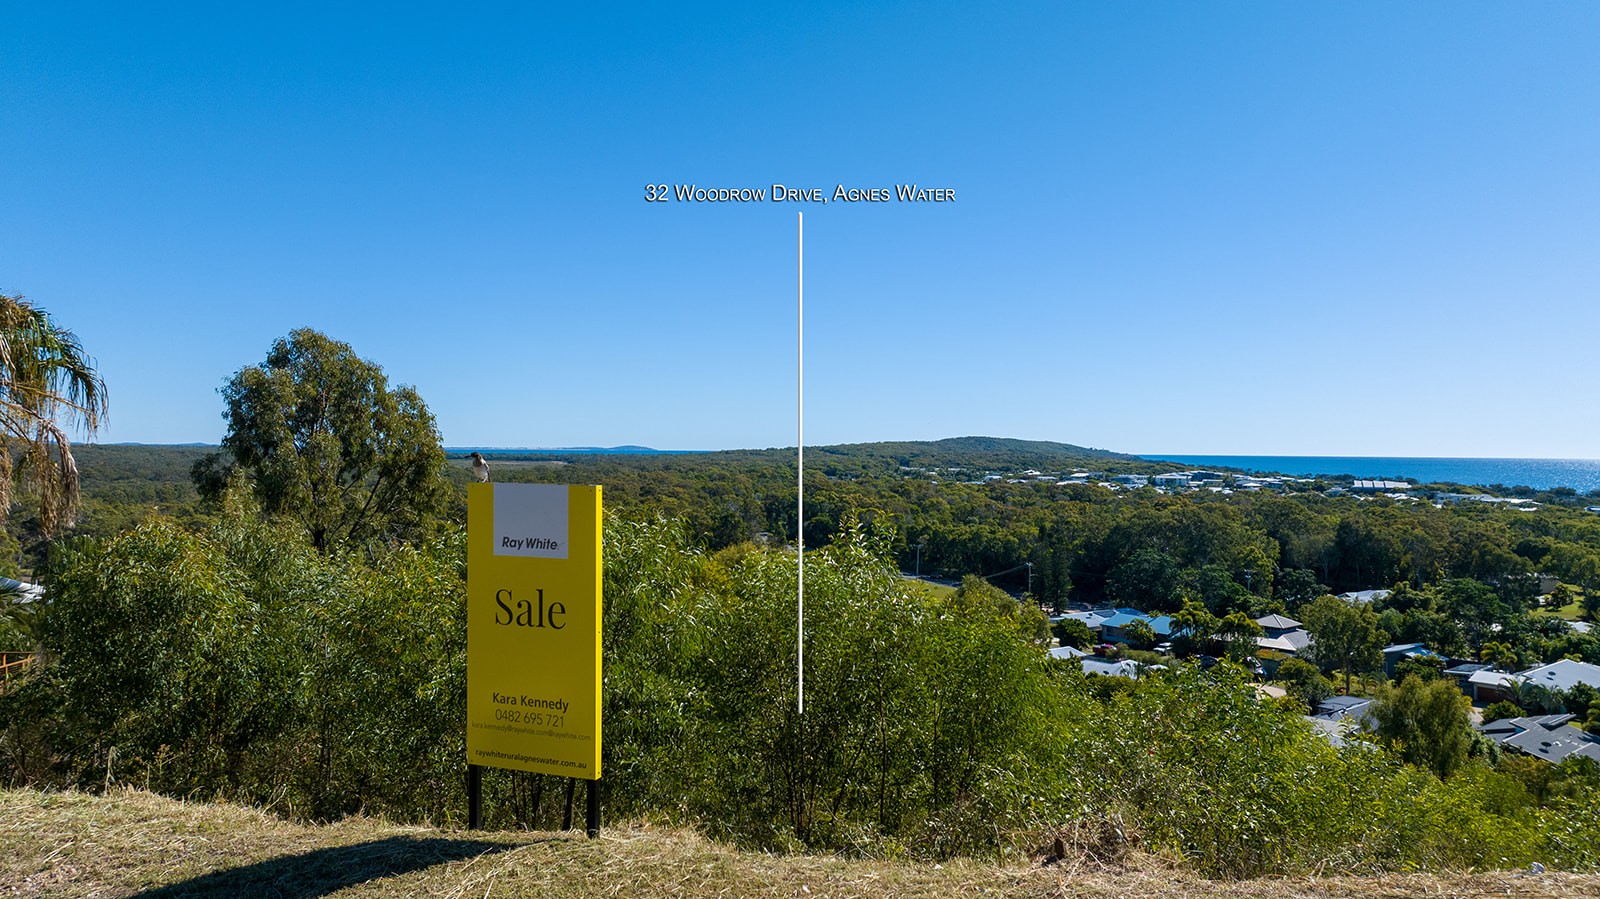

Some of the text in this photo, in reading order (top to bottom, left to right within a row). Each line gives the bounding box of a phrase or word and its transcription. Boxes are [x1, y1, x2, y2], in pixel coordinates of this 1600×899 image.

[502, 536, 524, 551] Ray
[495, 588, 566, 629] Sale
[492, 692, 569, 713] Kara Kennedy
[495, 708, 565, 729] 0482 695 721
[475, 749, 587, 768] raywhiteruralagneswater.com.au
